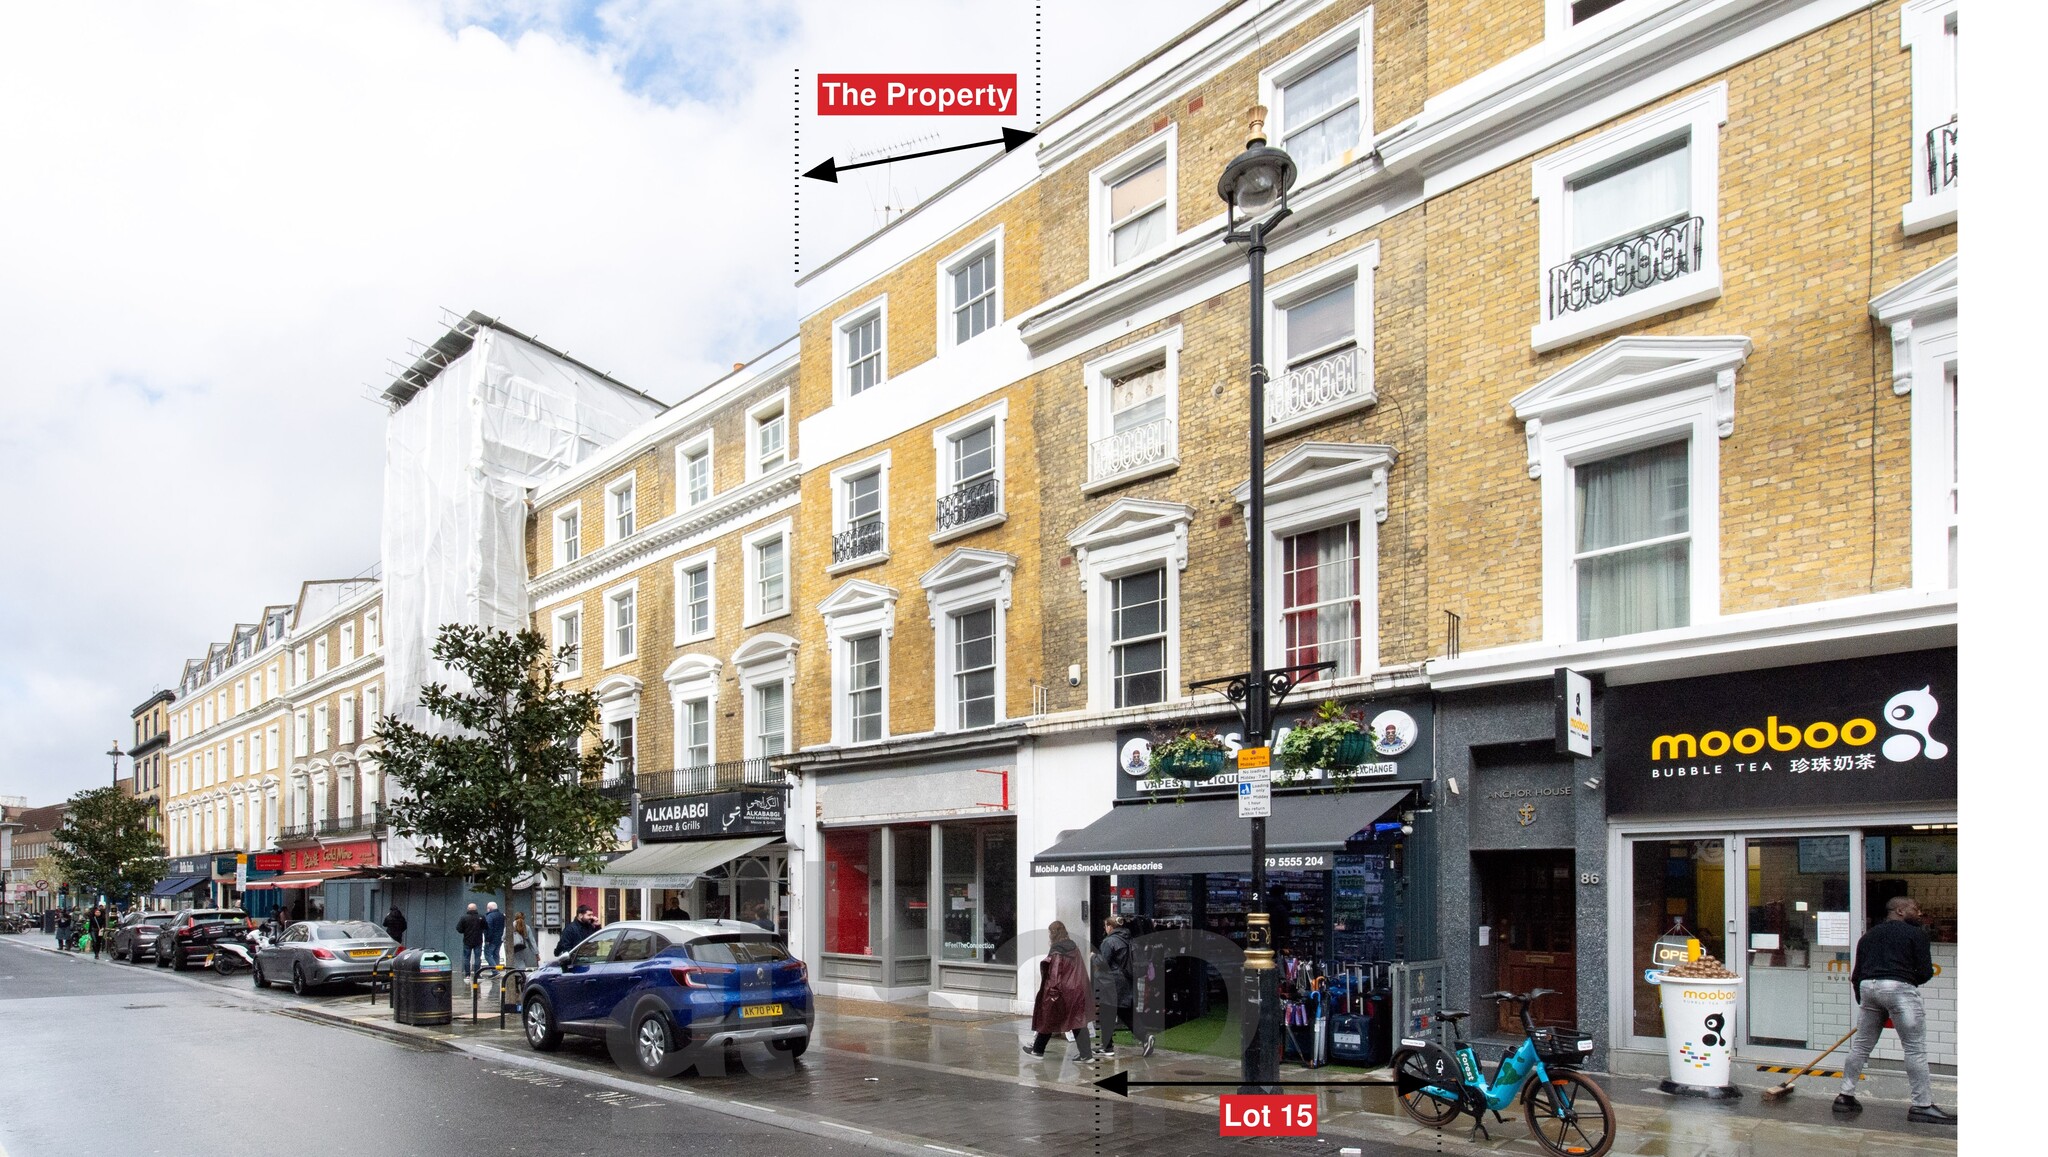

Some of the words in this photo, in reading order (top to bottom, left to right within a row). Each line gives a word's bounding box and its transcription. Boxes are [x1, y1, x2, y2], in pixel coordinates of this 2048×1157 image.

[1652, 716, 1877, 761] mooboo
[1652, 764, 1722, 778] BUBBLE
[1736, 761, 1772, 773] TEA
[1789, 753, 1877, 773] 珍珠奶茶
[1488, 789, 1532, 800] ANCHOR
[1535, 786, 1571, 797] HOUSE
[645, 803, 709, 823] ALKABABGI
[746, 810, 780, 818] ALKABABGI
[651, 822, 673, 833] Mezze
[674, 820, 681, 831] &
[682, 817, 701, 831] Grills
[1035, 864, 1059, 873] Mobile
[1060, 864, 1075, 873] And
[1076, 863, 1111, 874] Smoking
[1112, 861, 1163, 872] Accessories
[1278, 857, 1302, 867] 5555
[1305, 856, 1323, 867] 204
[1581, 873, 1599, 885] 86
[1252, 892, 1258, 901] 2
[1659, 948, 1689, 962] OPE
[1683, 989, 1736, 1001] mooboo
[744, 1006, 764, 1017] AK70
[766, 1004, 781, 1015] PVZ
[1461, 1053, 1475, 1081] forest
